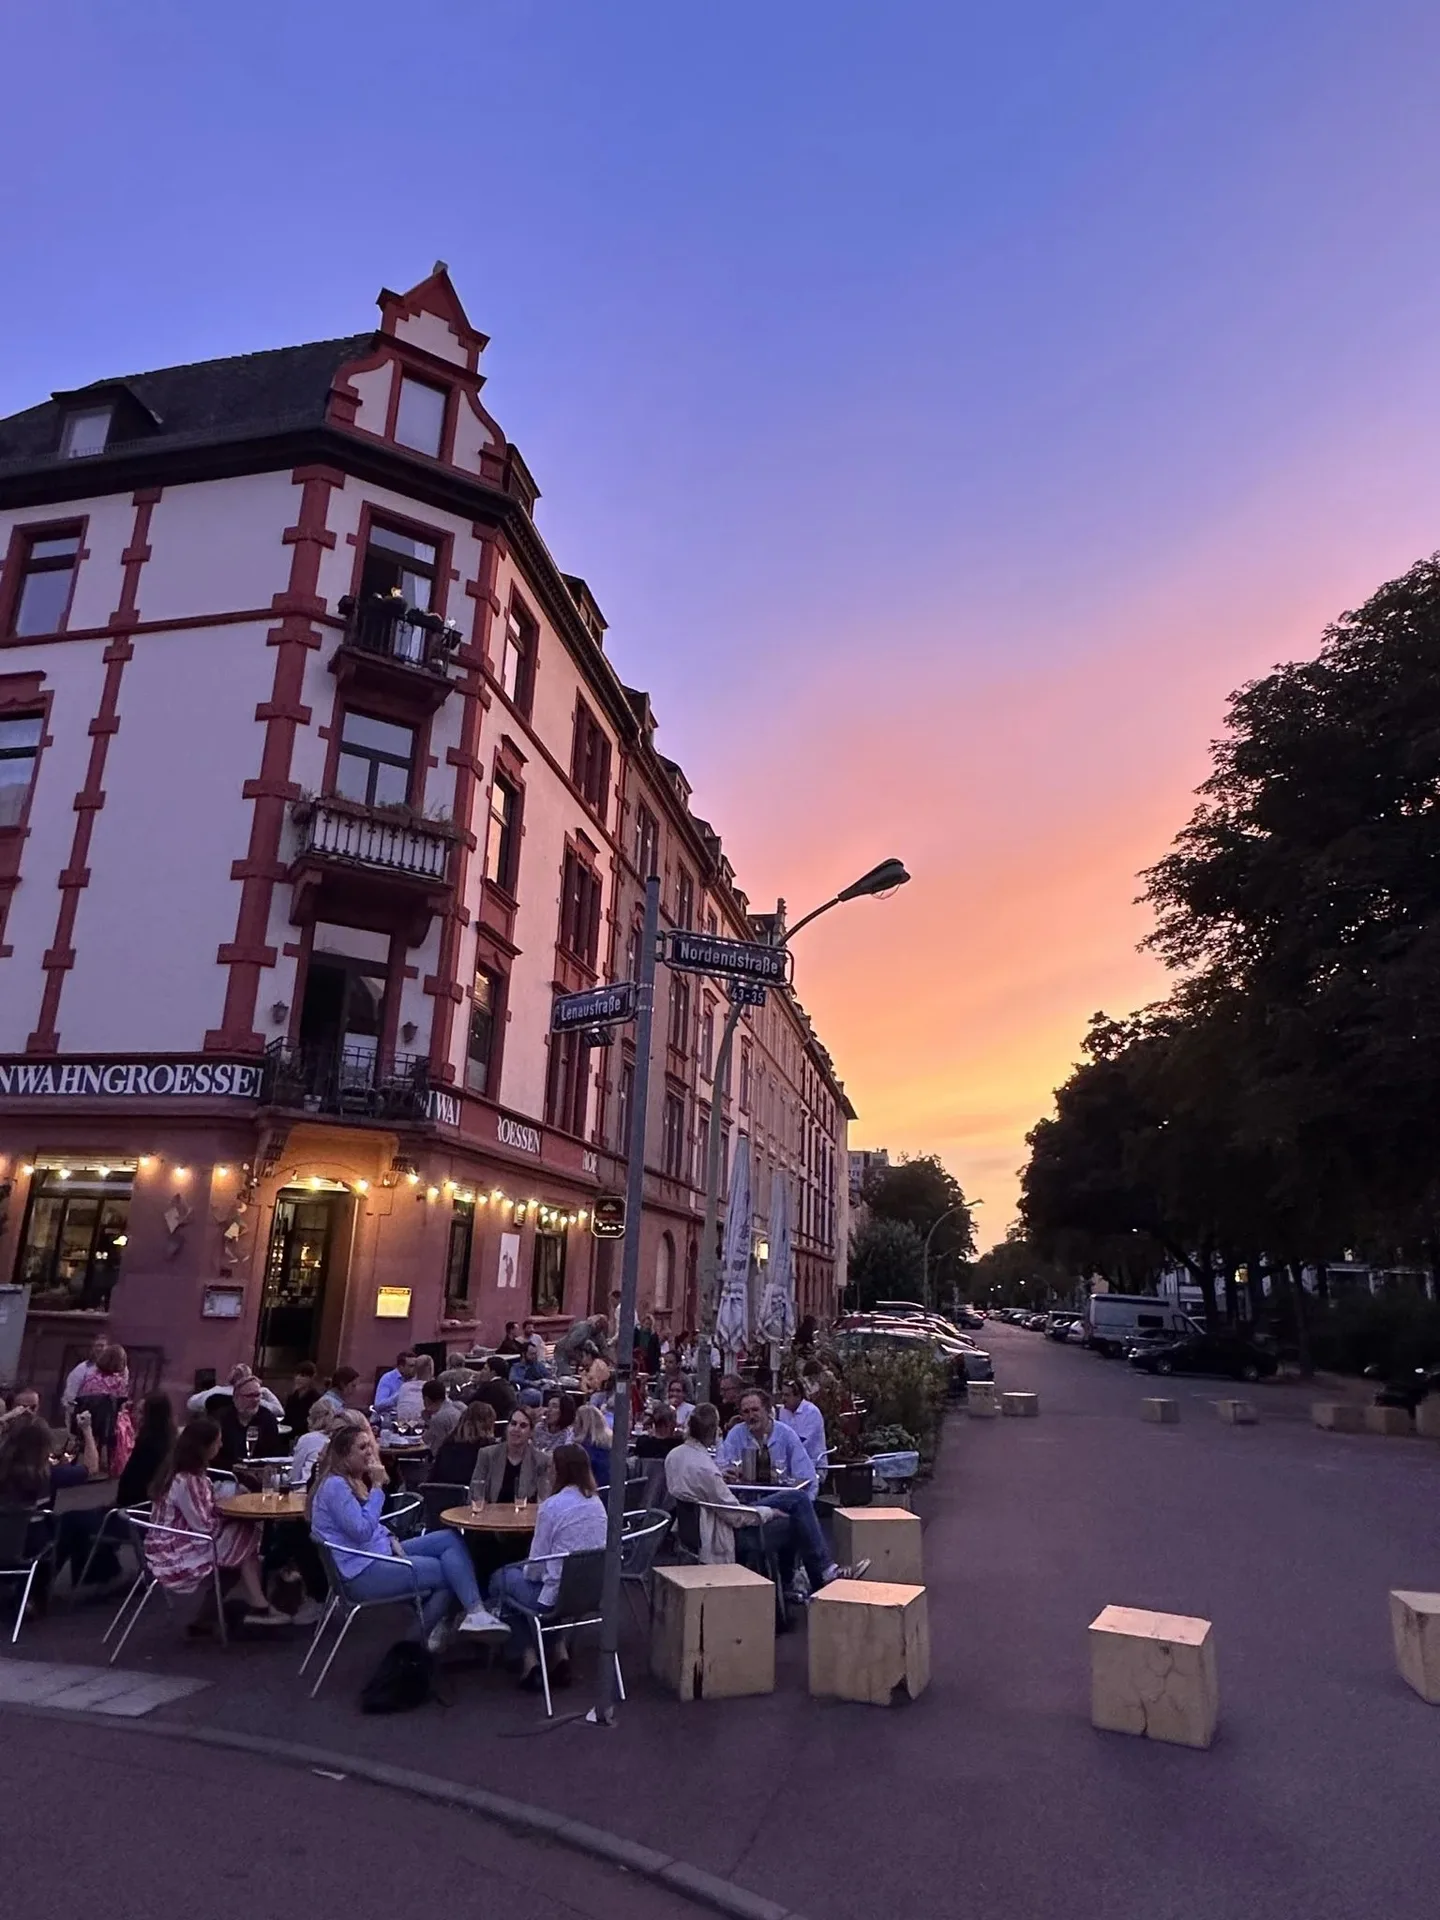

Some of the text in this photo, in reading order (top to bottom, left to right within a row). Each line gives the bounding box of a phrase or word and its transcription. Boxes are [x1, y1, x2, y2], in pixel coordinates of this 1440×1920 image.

[680, 941, 779, 975] Nordendstraße
[561, 995, 621, 1022] Lenaustraße
[731, 987, 764, 1005] 43-35
